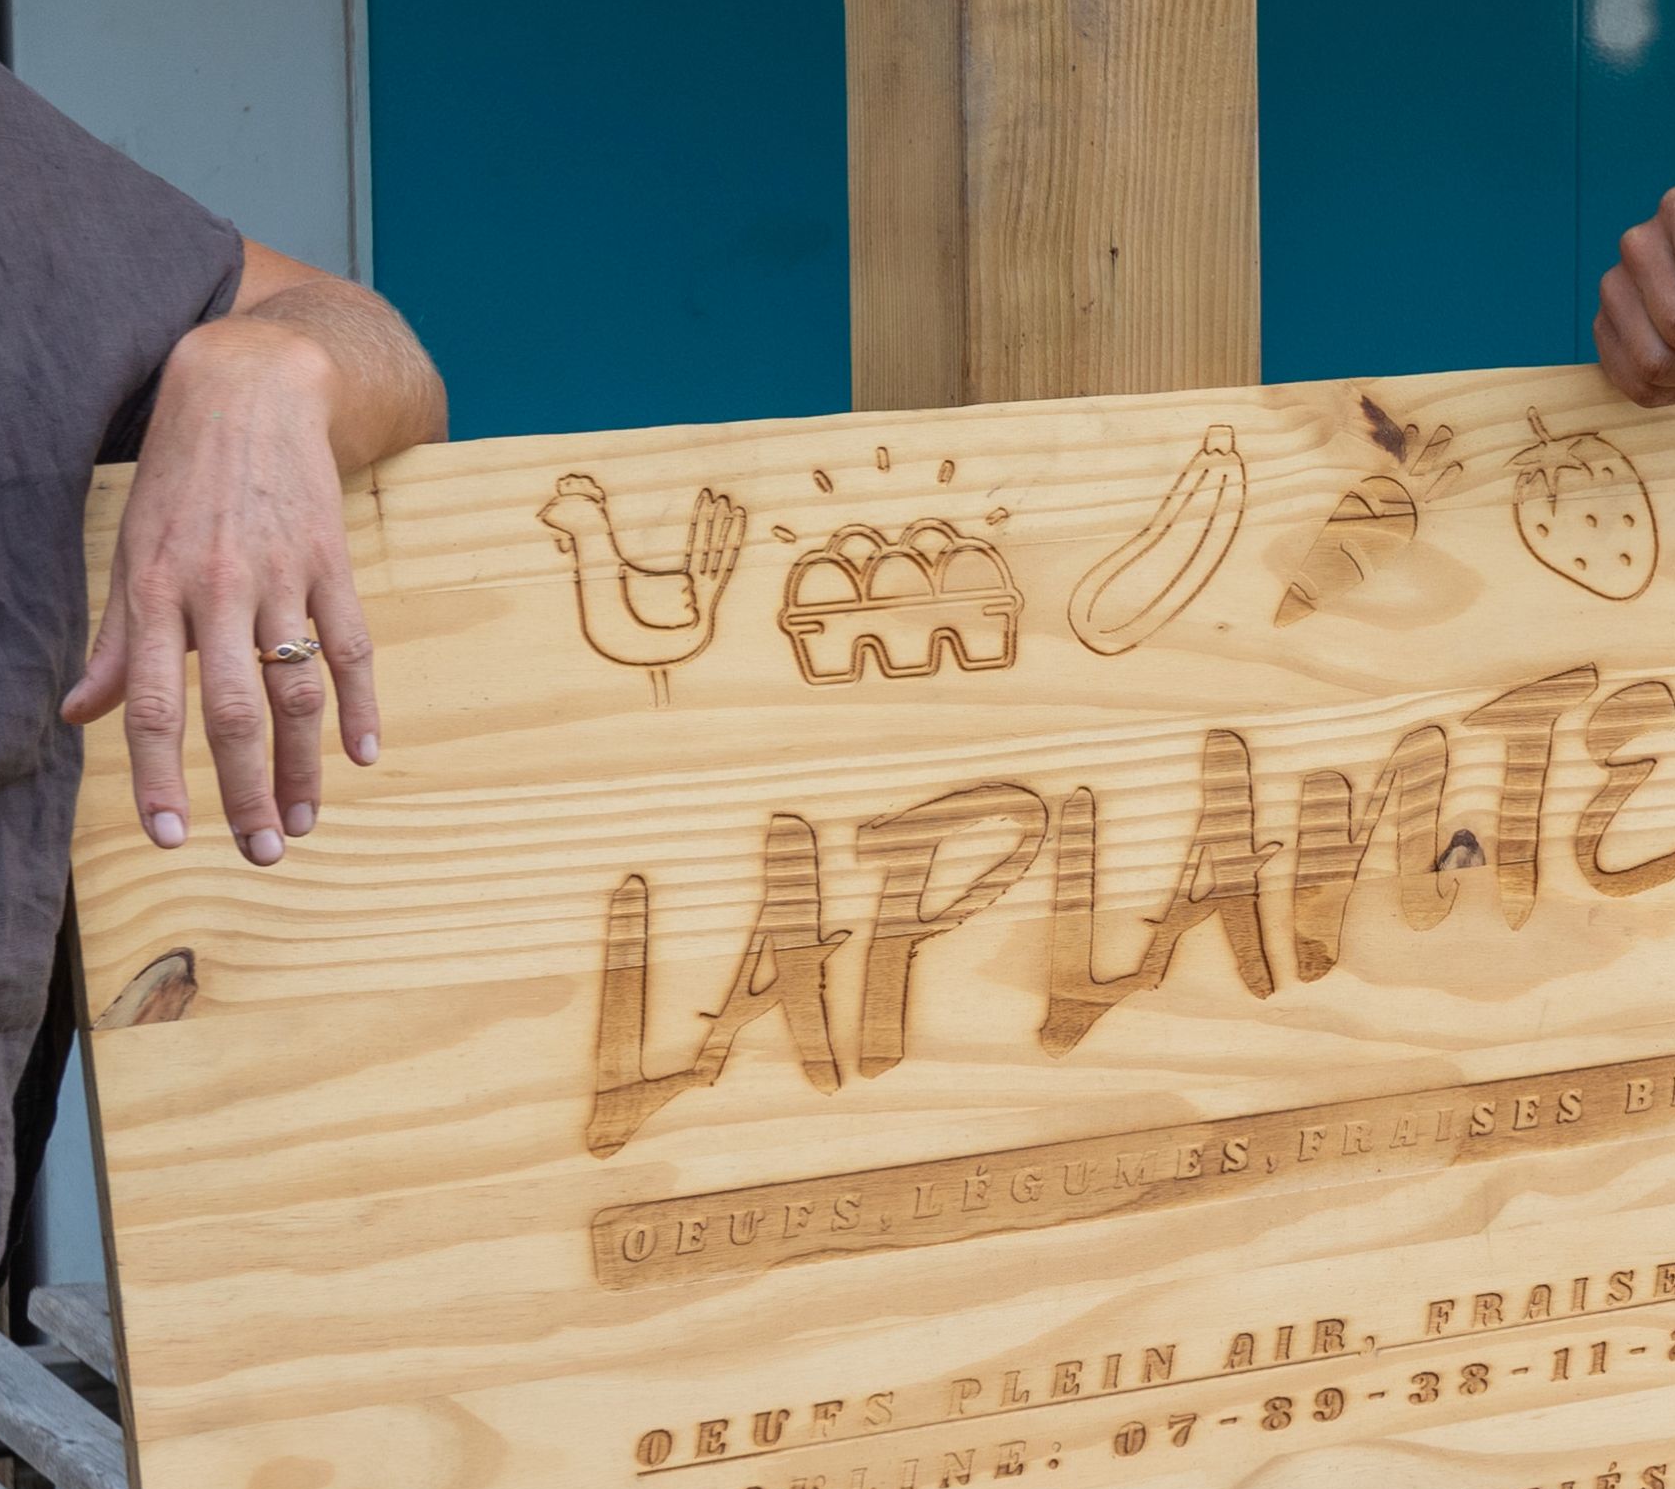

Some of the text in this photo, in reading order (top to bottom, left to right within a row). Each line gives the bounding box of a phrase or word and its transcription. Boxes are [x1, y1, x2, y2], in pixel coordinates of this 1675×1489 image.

[635, 1389, 897, 1469] OEUFS
[946, 1342, 1178, 1417] PLEIN
[1223, 1316, 1380, 1371] AIR,
